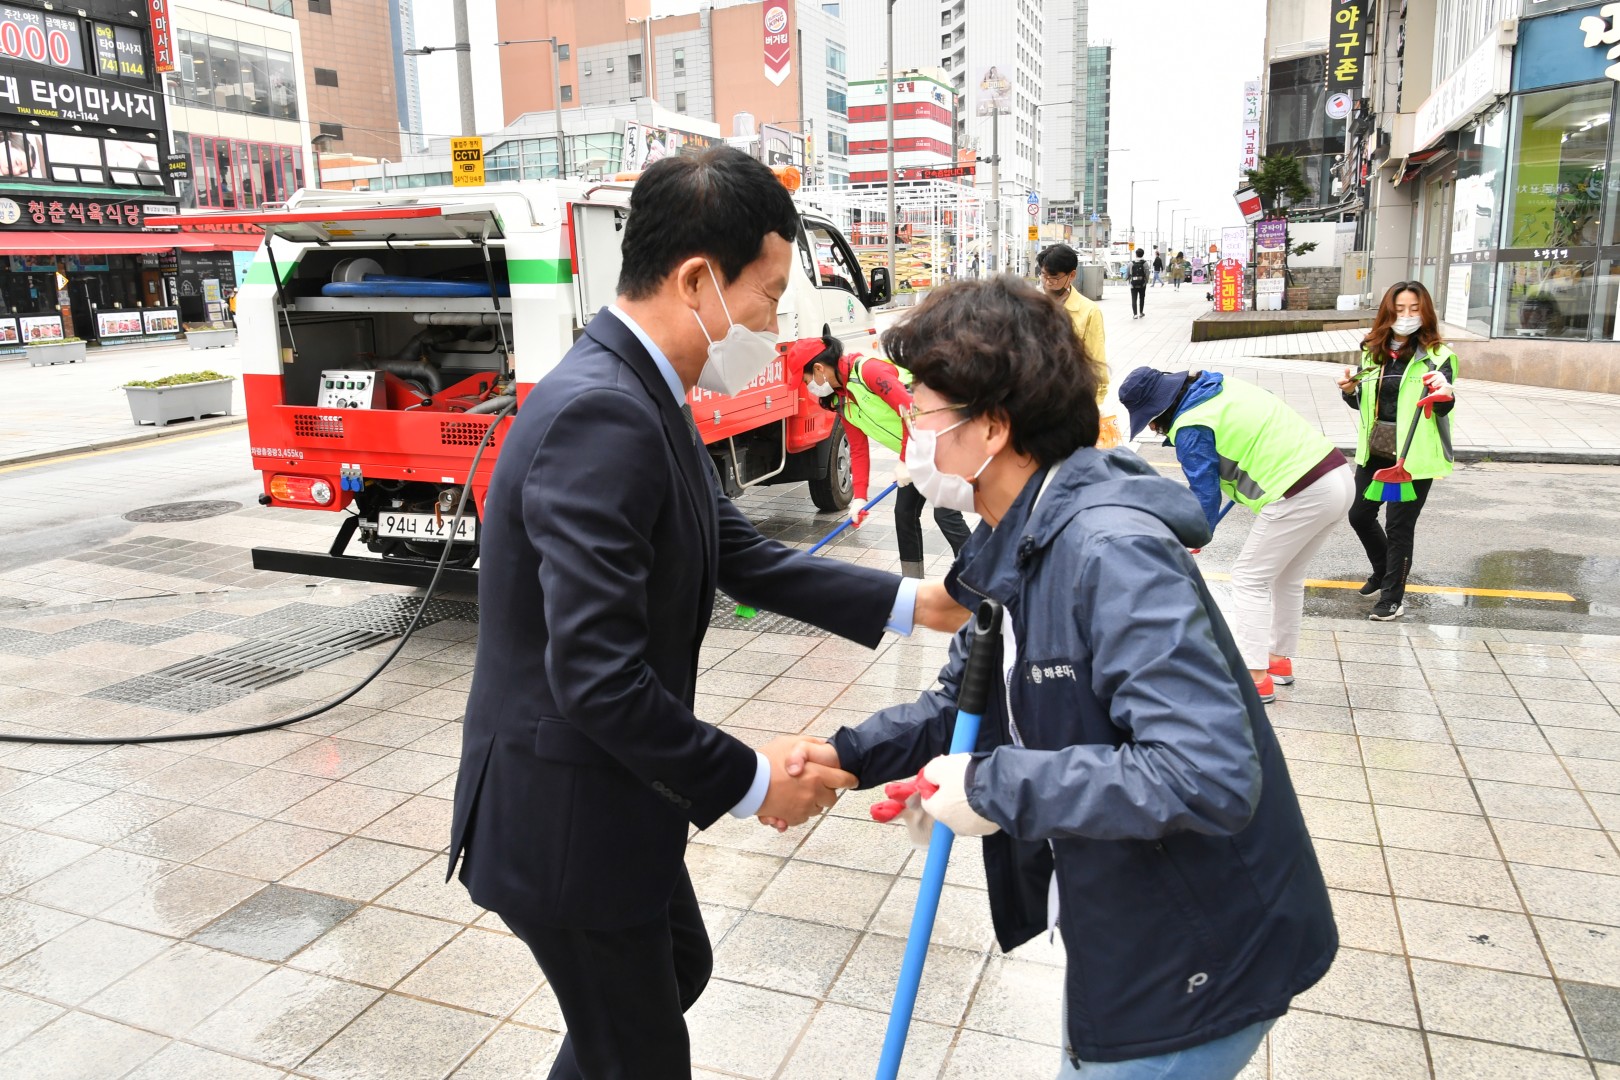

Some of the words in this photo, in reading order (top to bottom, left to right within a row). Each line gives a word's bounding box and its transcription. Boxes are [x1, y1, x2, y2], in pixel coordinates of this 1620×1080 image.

[765, 33, 788, 46] 버거킹
[1334, 5, 1361, 82] 야구존
[100, 57, 118, 72] 741
[121, 61, 144, 76] 1144
[897, 81, 915, 93] 모텔
[30, 79, 157, 121] 타이마사지
[1246, 96, 1258, 118] 낙지
[16, 106, 31, 115] THAI
[33, 108, 59, 118] MASSAGE
[61, 109, 100, 122] 741-1144
[455, 151, 479, 160] CCTV
[1243, 128, 1257, 168] 낙곱새
[168, 161, 187, 170] 24시간
[454, 175, 469, 184] 24시간
[28, 200, 140, 226] 청춘식육식당
[1260, 223, 1283, 234] 궁타이
[1221, 270, 1235, 311] 노래방
[386, 516, 417, 534] 94너
[424, 518, 467, 537] 4214
